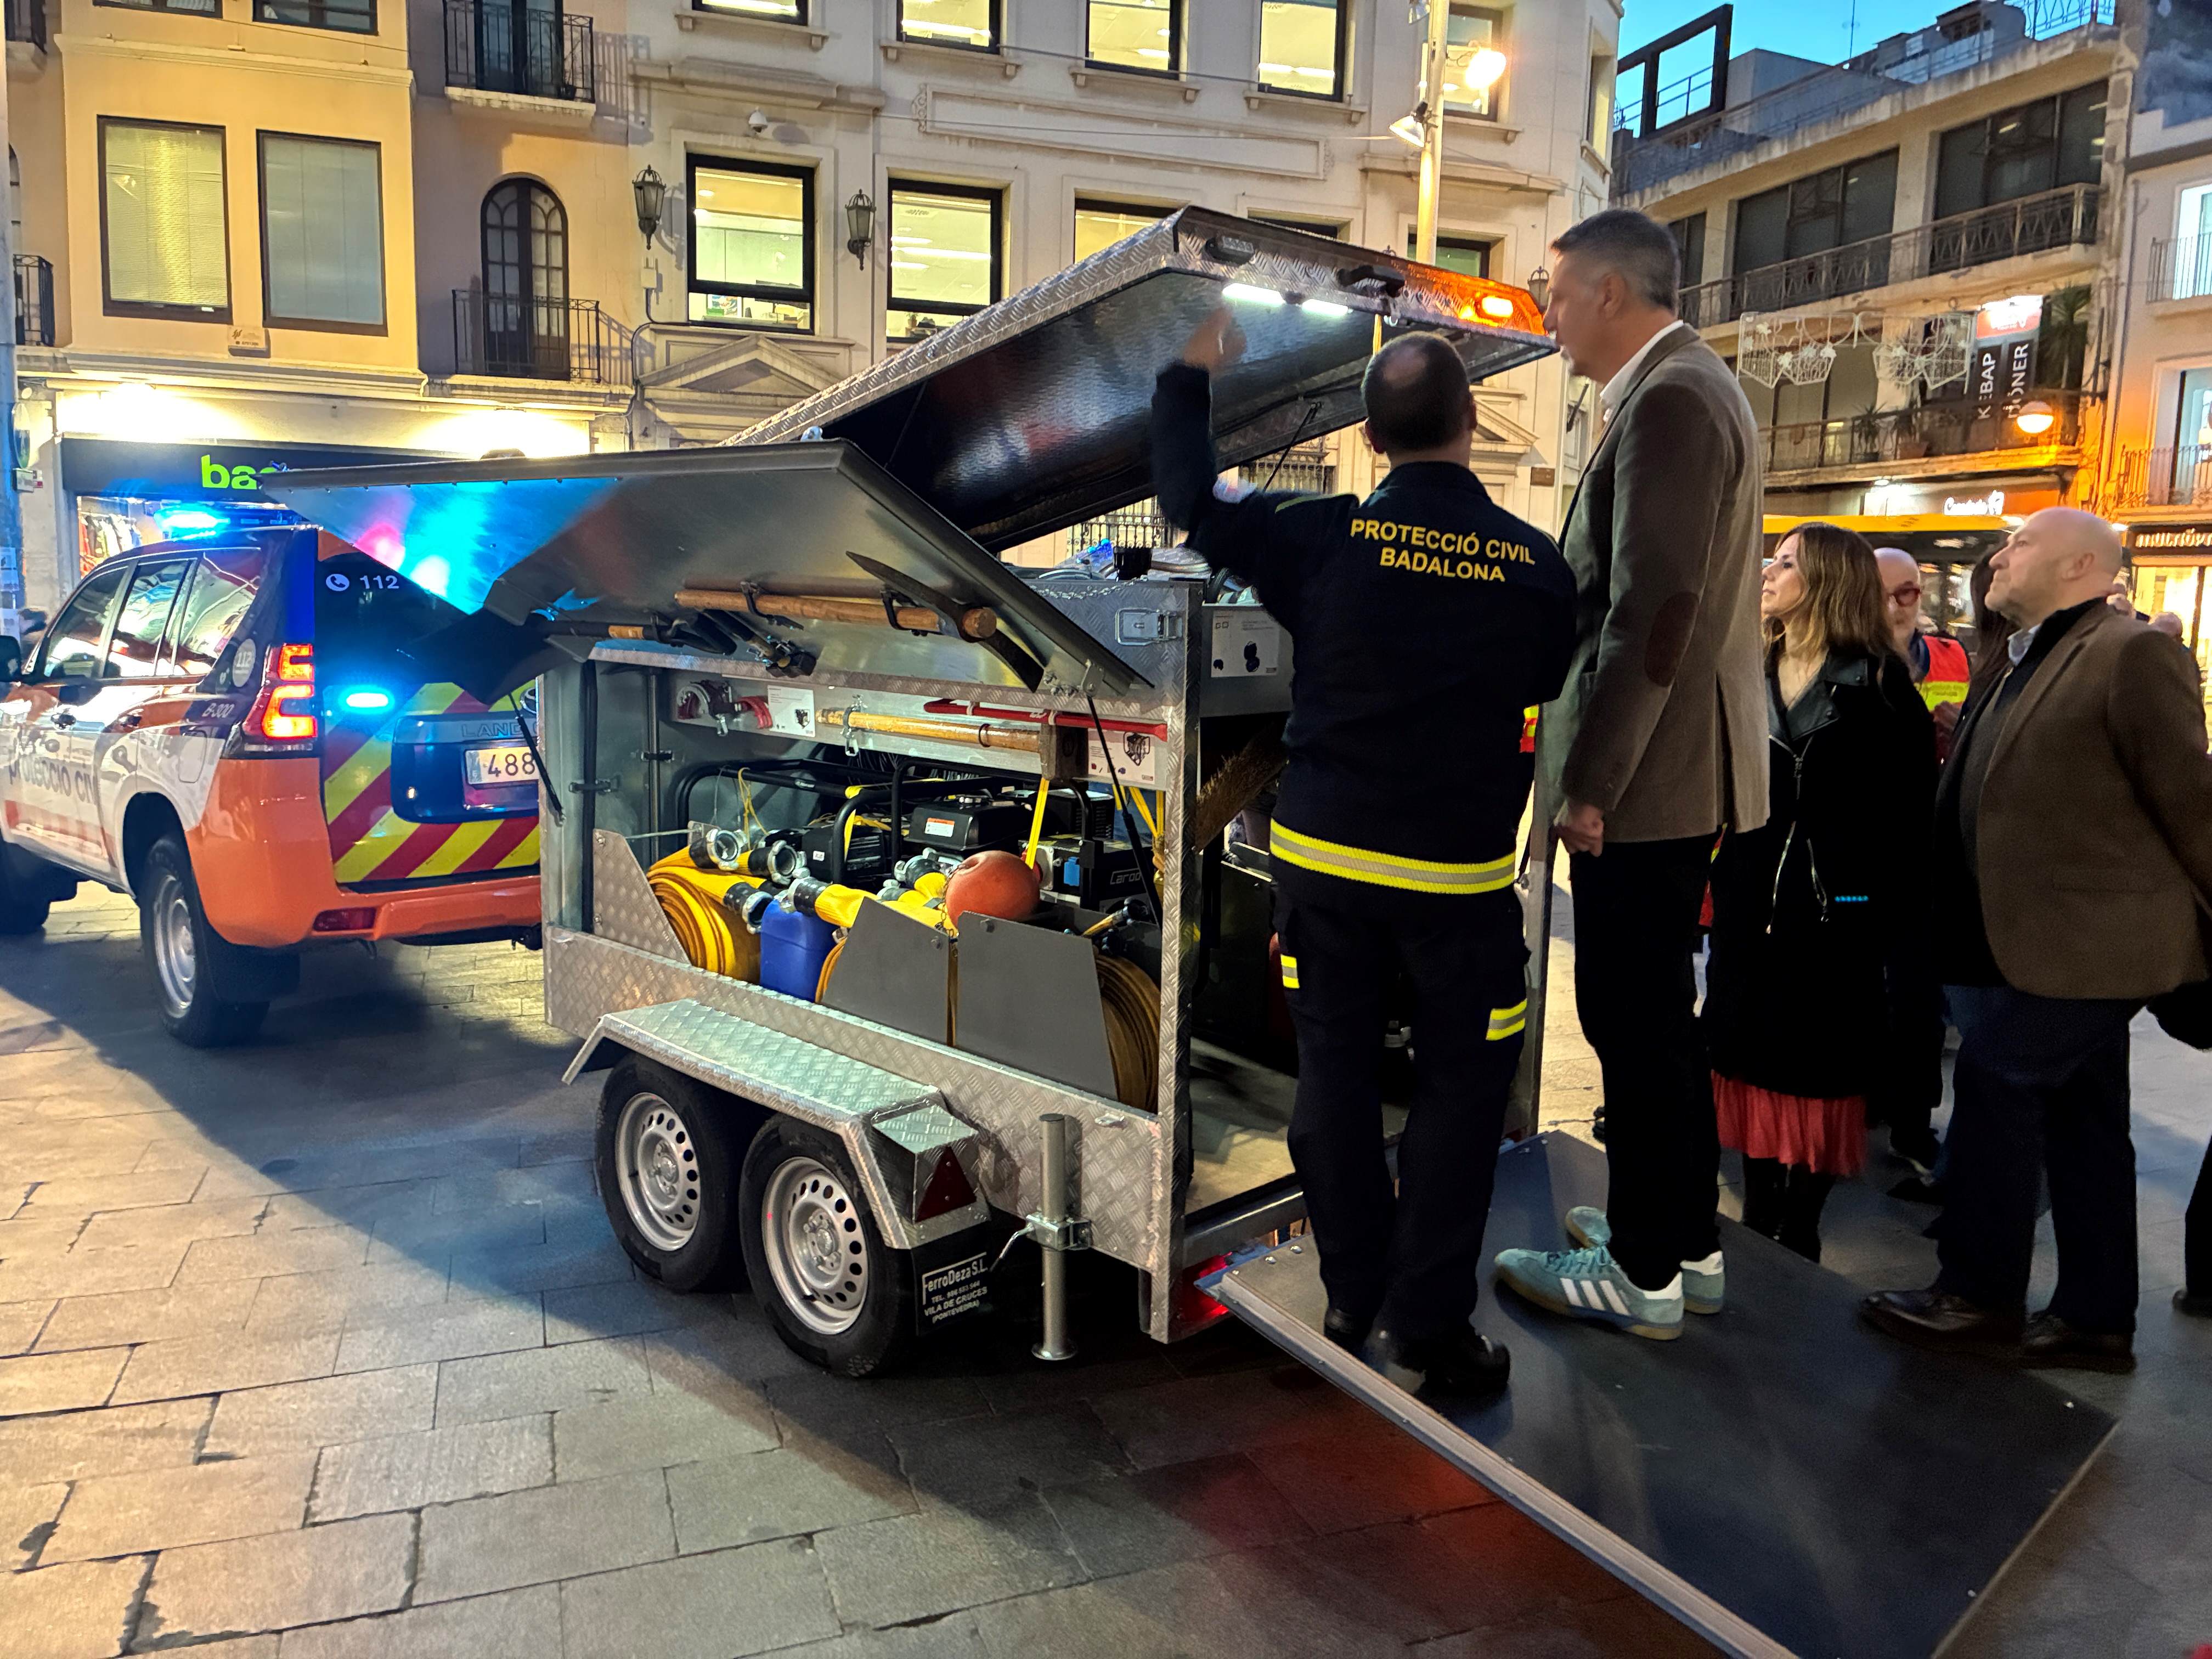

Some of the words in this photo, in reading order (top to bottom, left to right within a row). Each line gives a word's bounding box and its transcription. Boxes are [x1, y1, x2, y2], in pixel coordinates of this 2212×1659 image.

[201, 455, 278, 490] ba
[1350, 518, 1480, 556] PROTECCIÓ
[1486, 539, 1536, 566] CIVIL
[1380, 547, 1505, 582] BADALONA
[359, 575, 400, 590] 112
[236, 651, 253, 668] 112
[461, 722, 523, 738] LAND
[924, 1304, 943, 1317] VILA
[943, 1298, 955, 1310] DE
[956, 1286, 988, 1305] CRUCES
